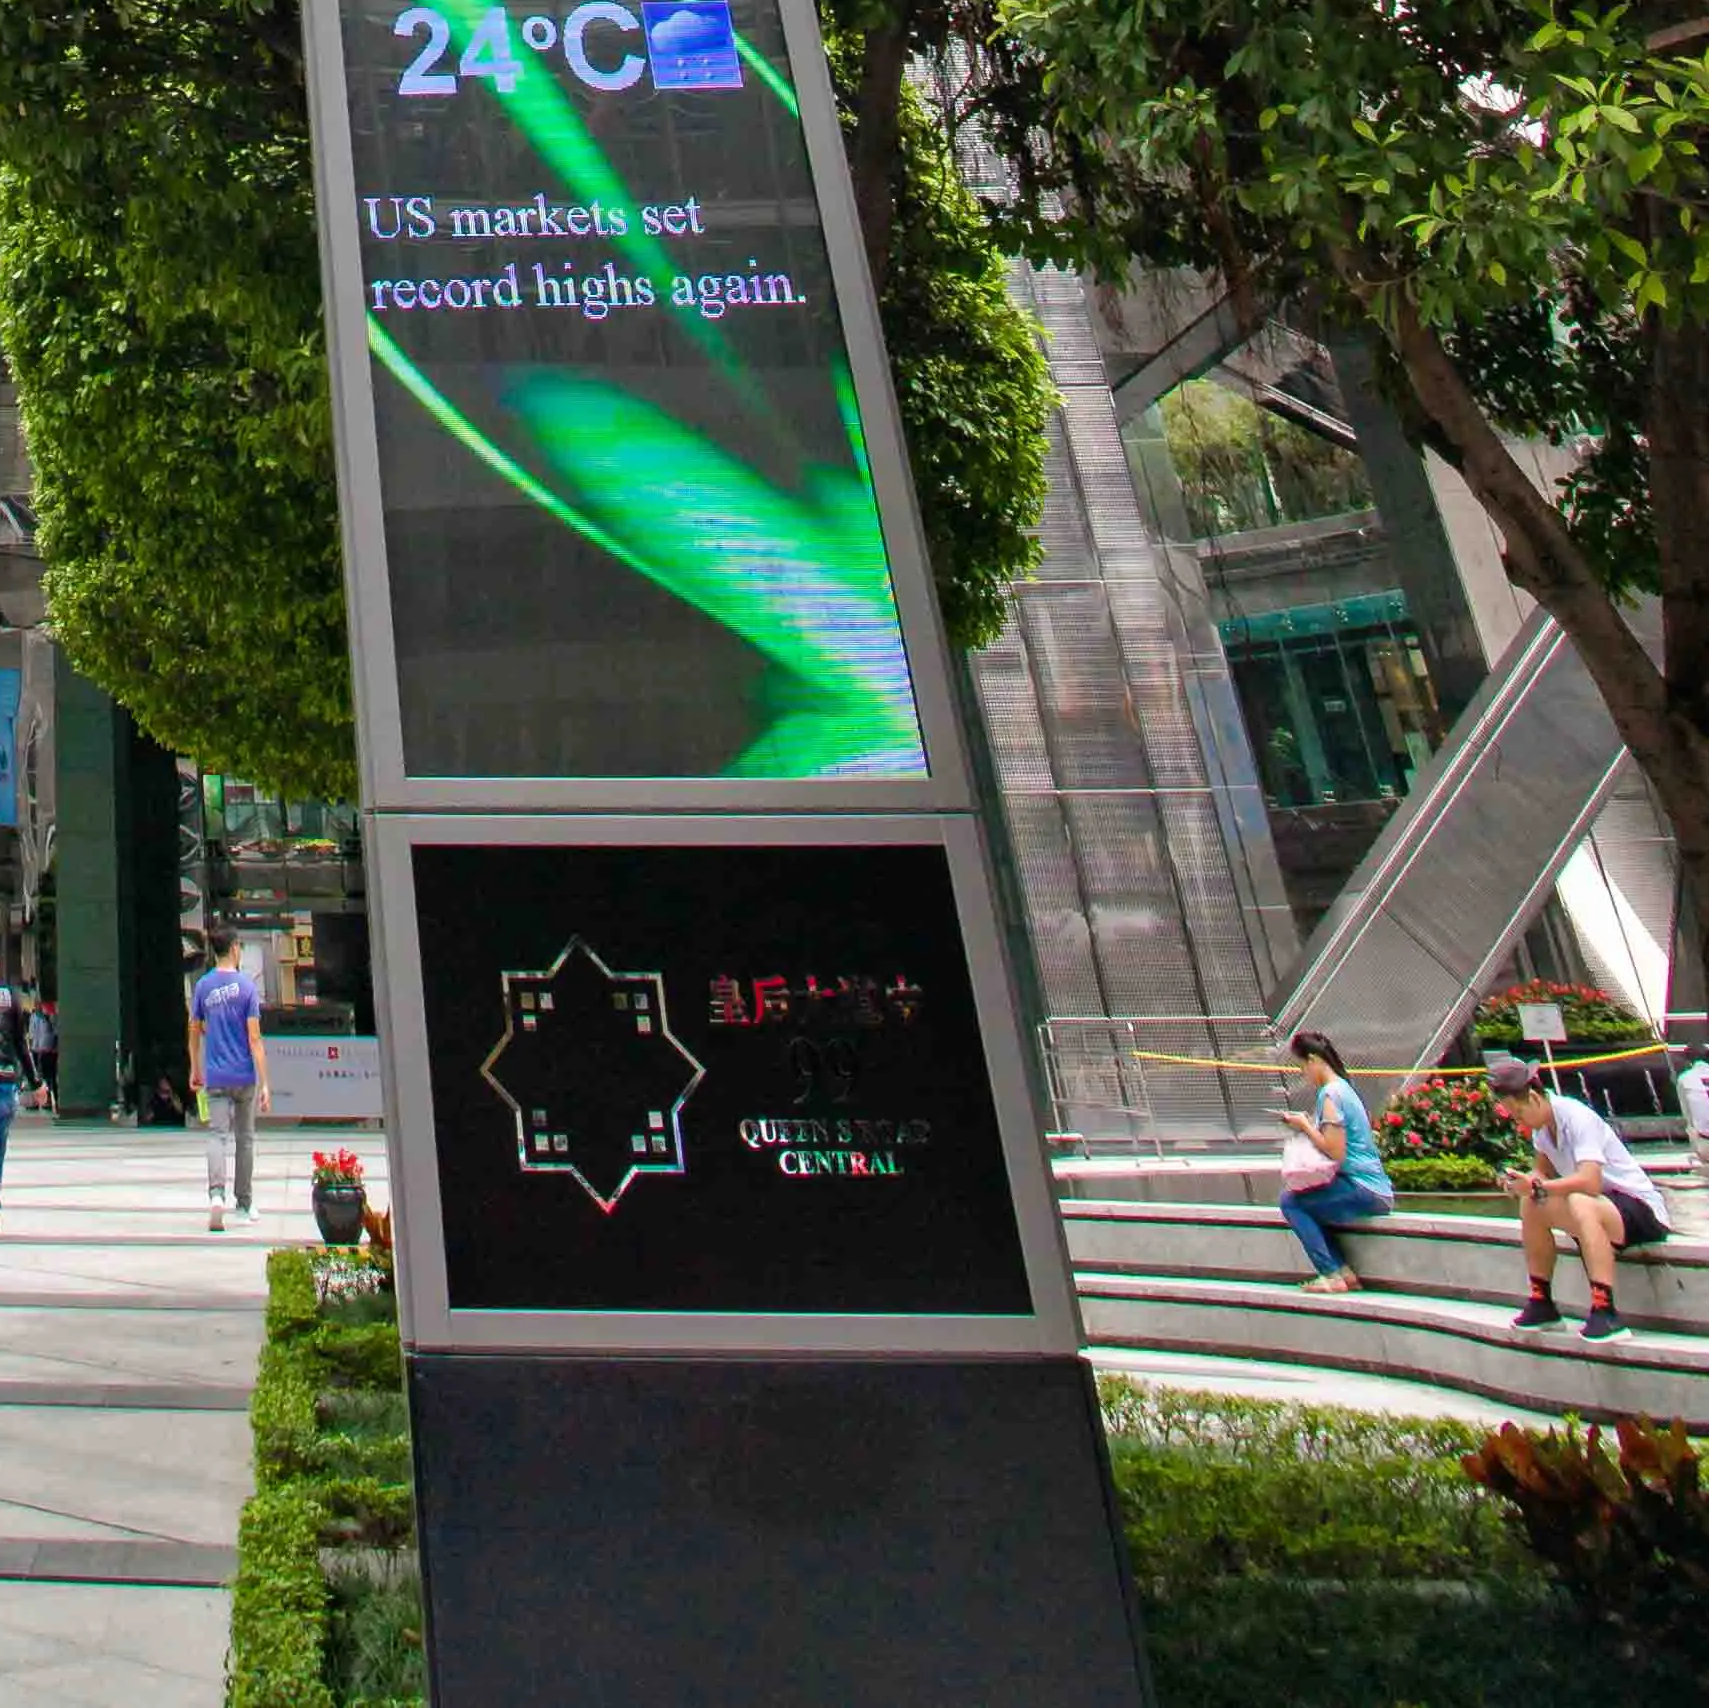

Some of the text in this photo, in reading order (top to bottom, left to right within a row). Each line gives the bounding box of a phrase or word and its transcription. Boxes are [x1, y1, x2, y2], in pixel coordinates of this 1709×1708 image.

[364, 192, 706, 240] US markets set
[371, 258, 808, 320] record highs again.
[778, 1150, 905, 1176] CENTRAL
